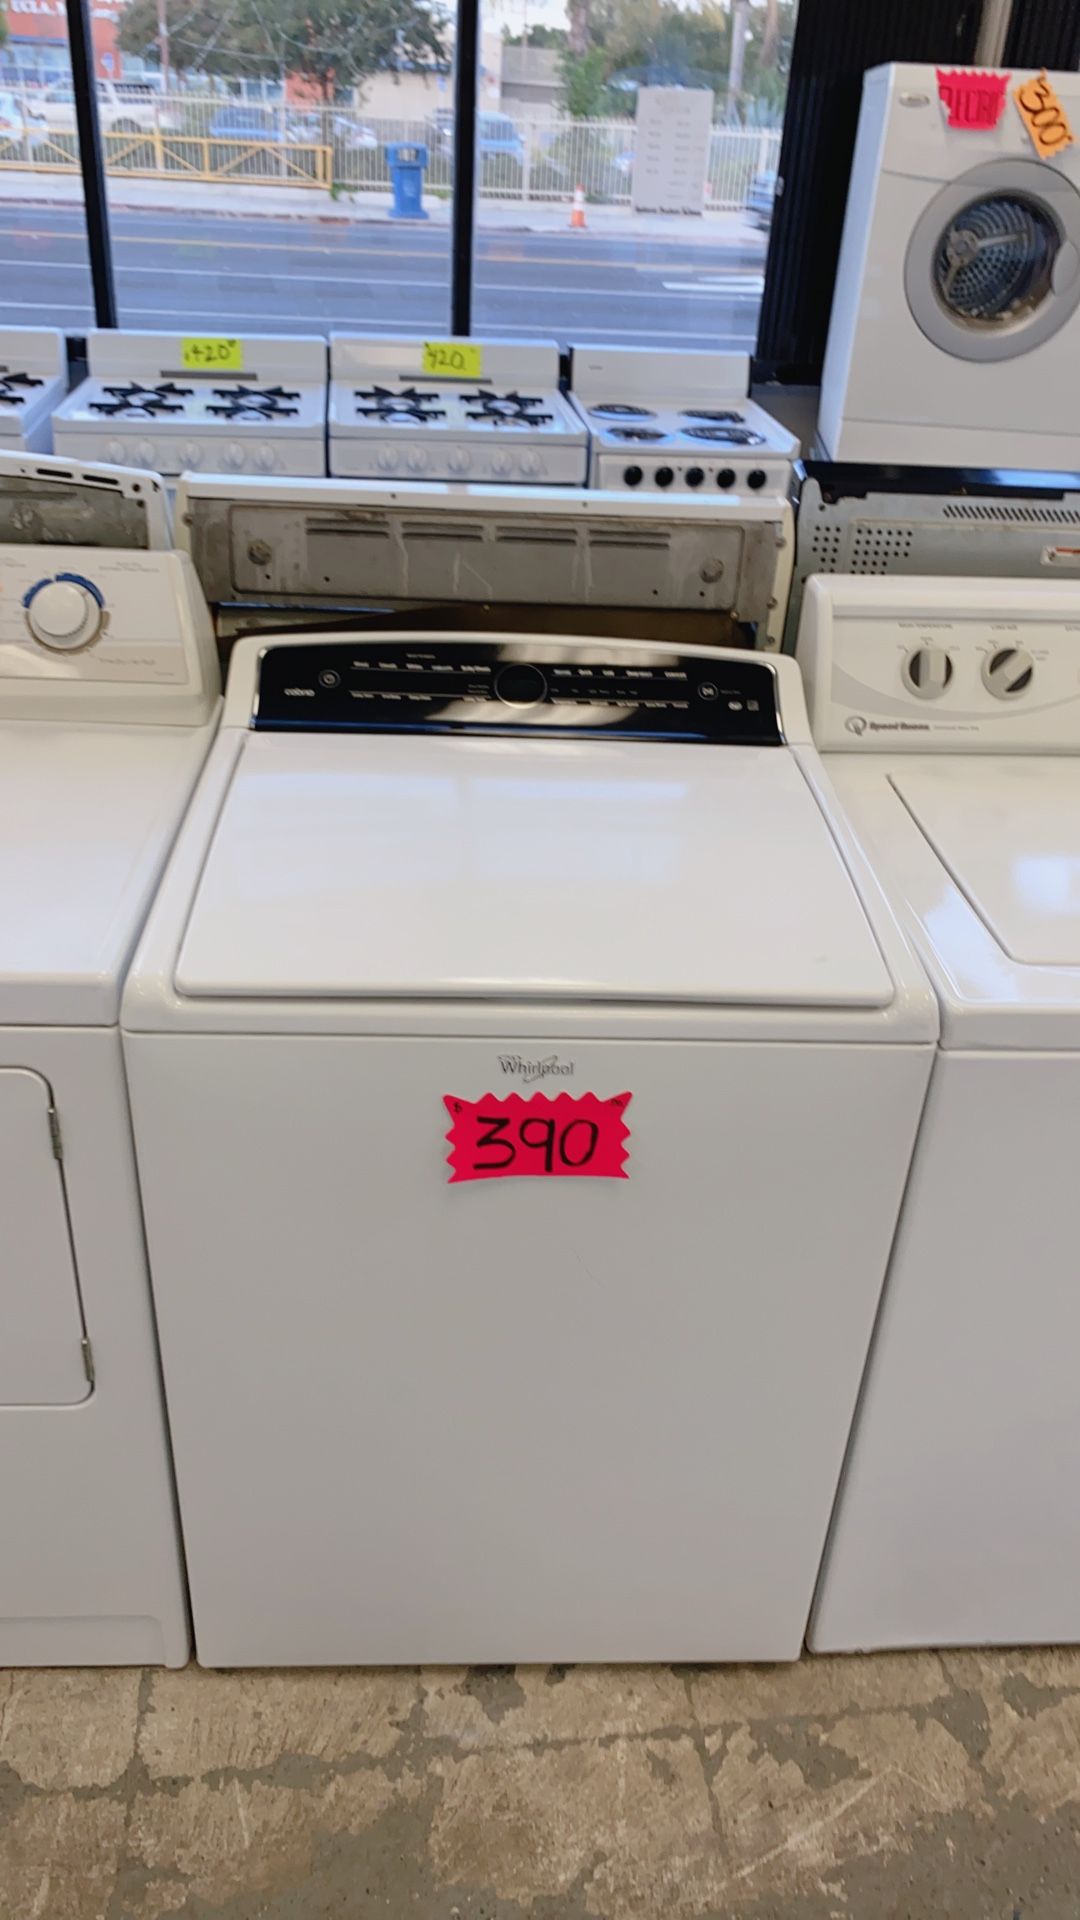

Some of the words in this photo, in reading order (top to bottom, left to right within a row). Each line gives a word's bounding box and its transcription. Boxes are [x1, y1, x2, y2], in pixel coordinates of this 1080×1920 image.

[1018, 77, 1067, 146] 300
[497, 1055, 574, 1080] Whirlpool
[472, 1115, 600, 1173] 390
